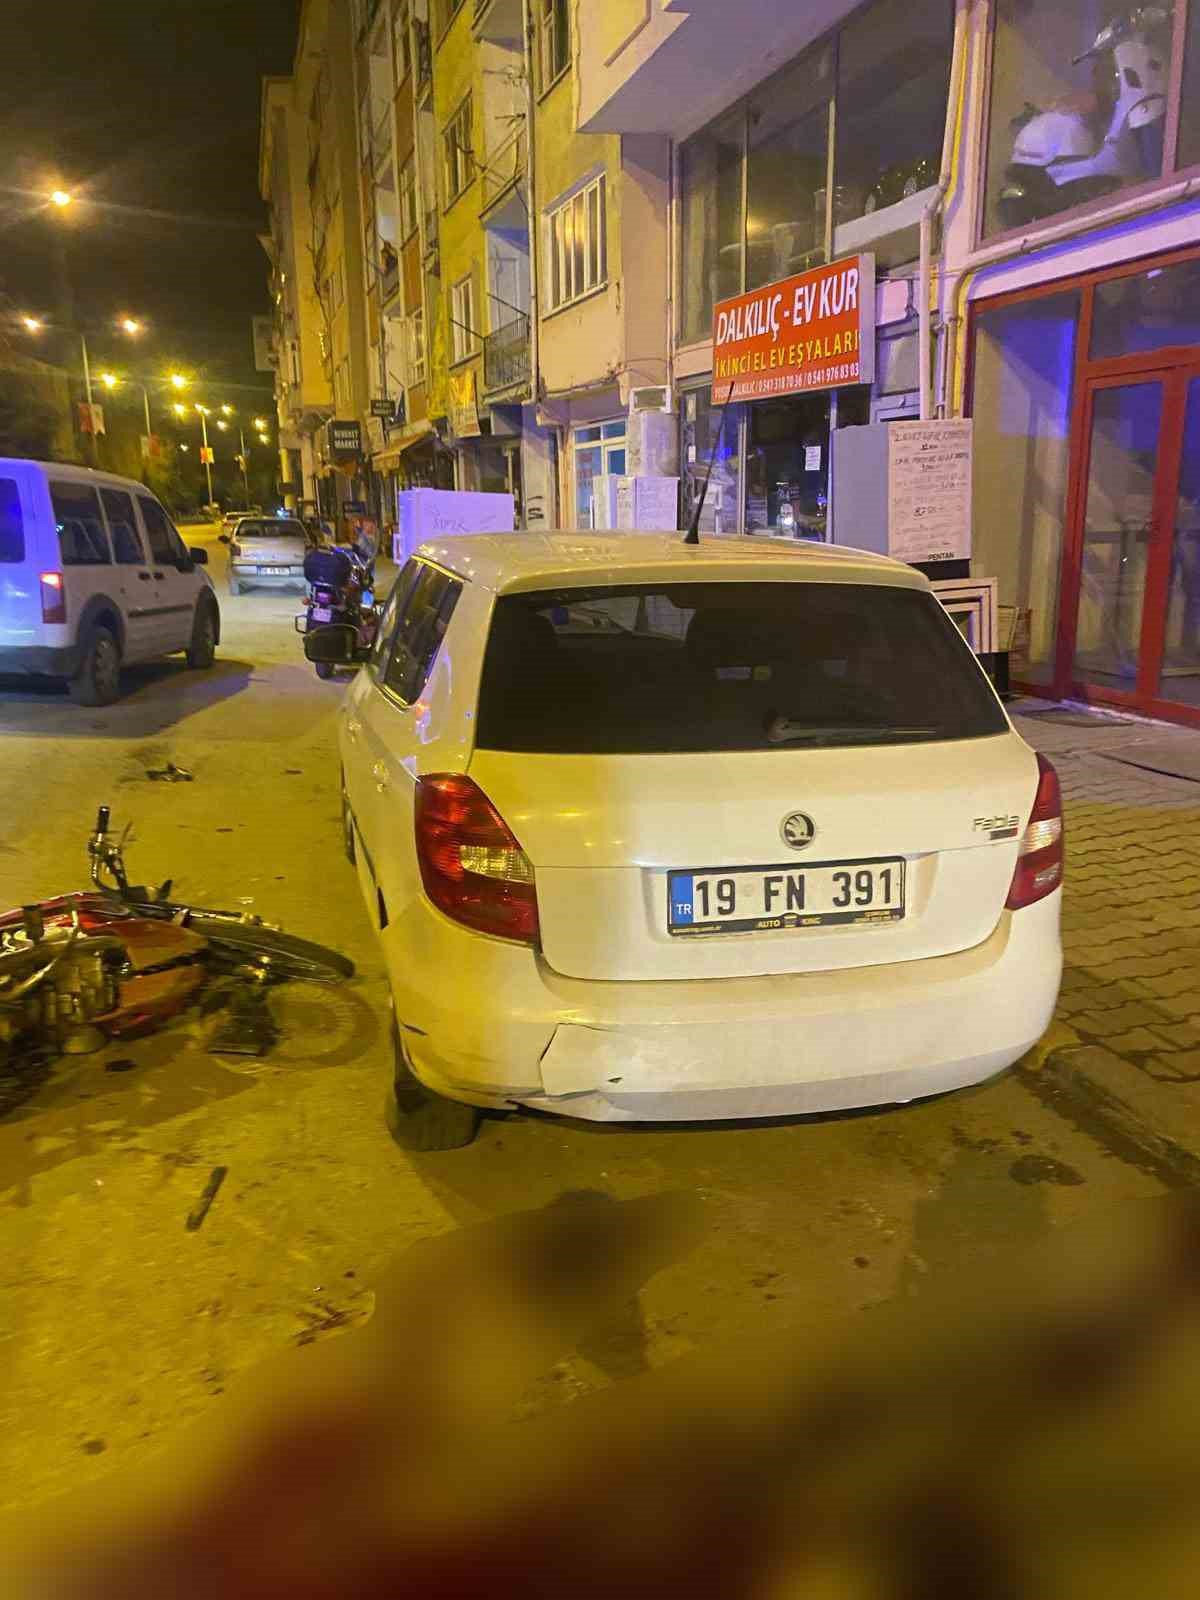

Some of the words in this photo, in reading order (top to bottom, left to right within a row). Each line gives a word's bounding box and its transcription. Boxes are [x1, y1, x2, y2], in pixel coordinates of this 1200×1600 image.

[716, 293, 782, 346] DALKILIÇ
[792, 283, 816, 326] EV
[819, 268, 859, 319] KUR
[715, 351, 751, 378] İKİNCİ
[754, 352, 767, 372] EL
[769, 345, 785, 369] EV
[789, 330, 860, 369] EŞYALARI
[676, 903, 692, 915] TR
[695, 878, 736, 917] 19
[763, 873, 806, 912] FN
[832, 868, 893, 908] 391
[757, 919, 781, 929] AUTO
